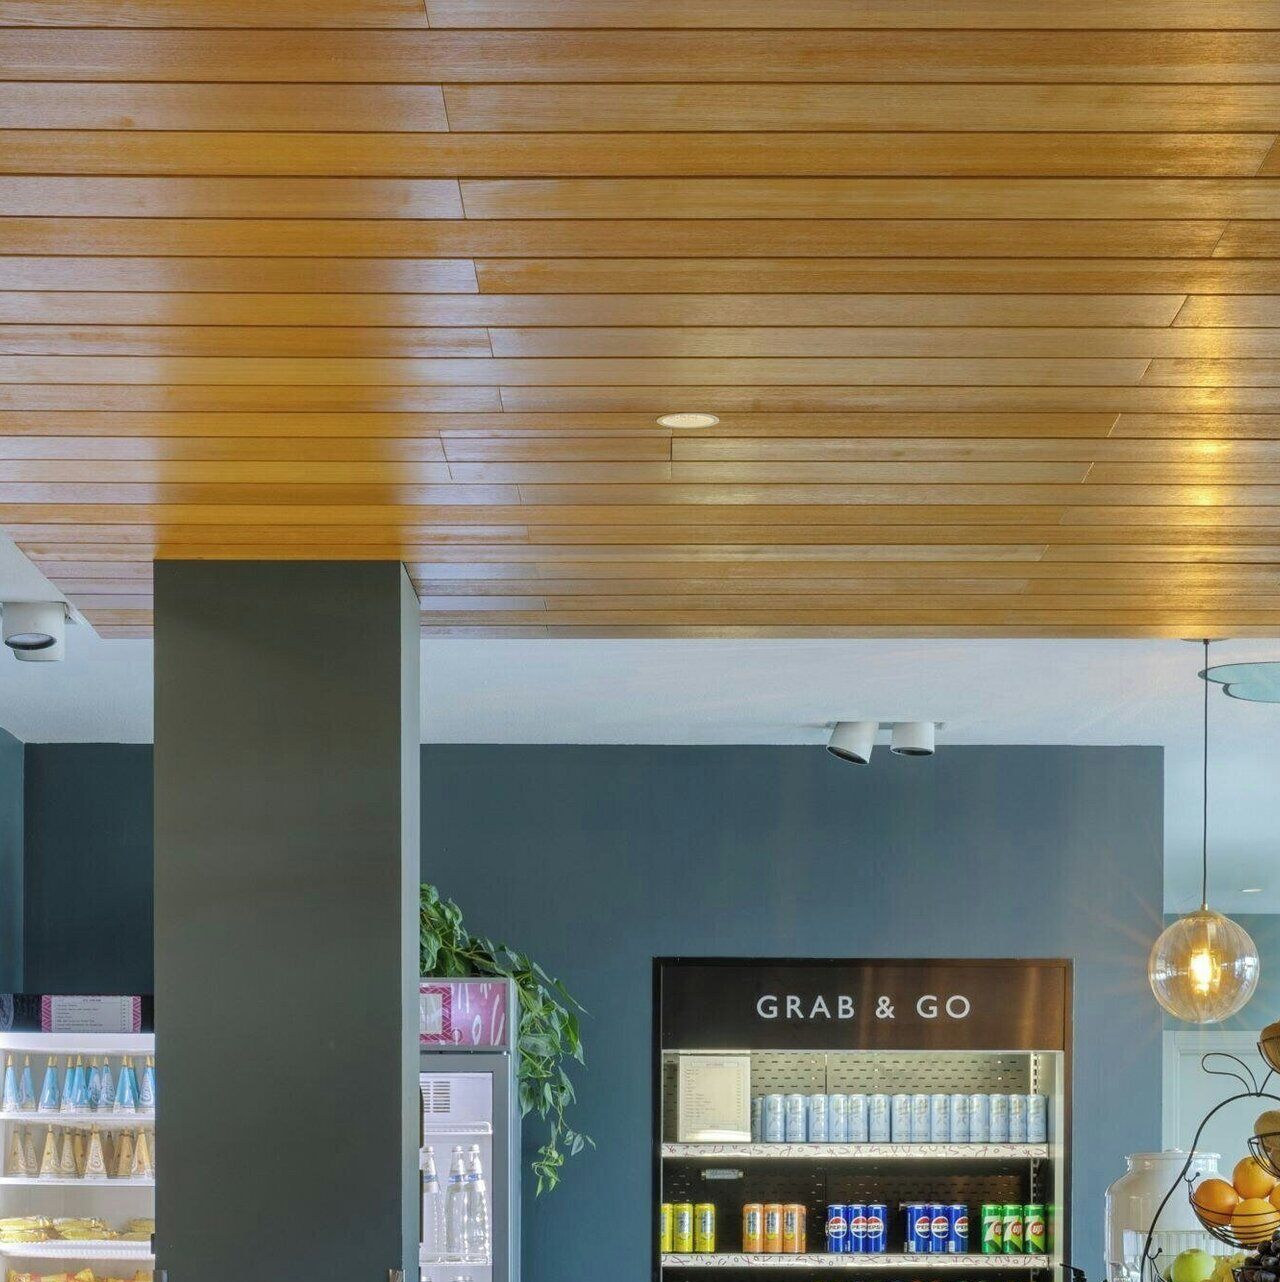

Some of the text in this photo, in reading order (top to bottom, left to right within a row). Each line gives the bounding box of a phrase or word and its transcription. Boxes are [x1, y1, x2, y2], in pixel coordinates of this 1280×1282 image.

[756, 995, 972, 1020] GRAB & GO
